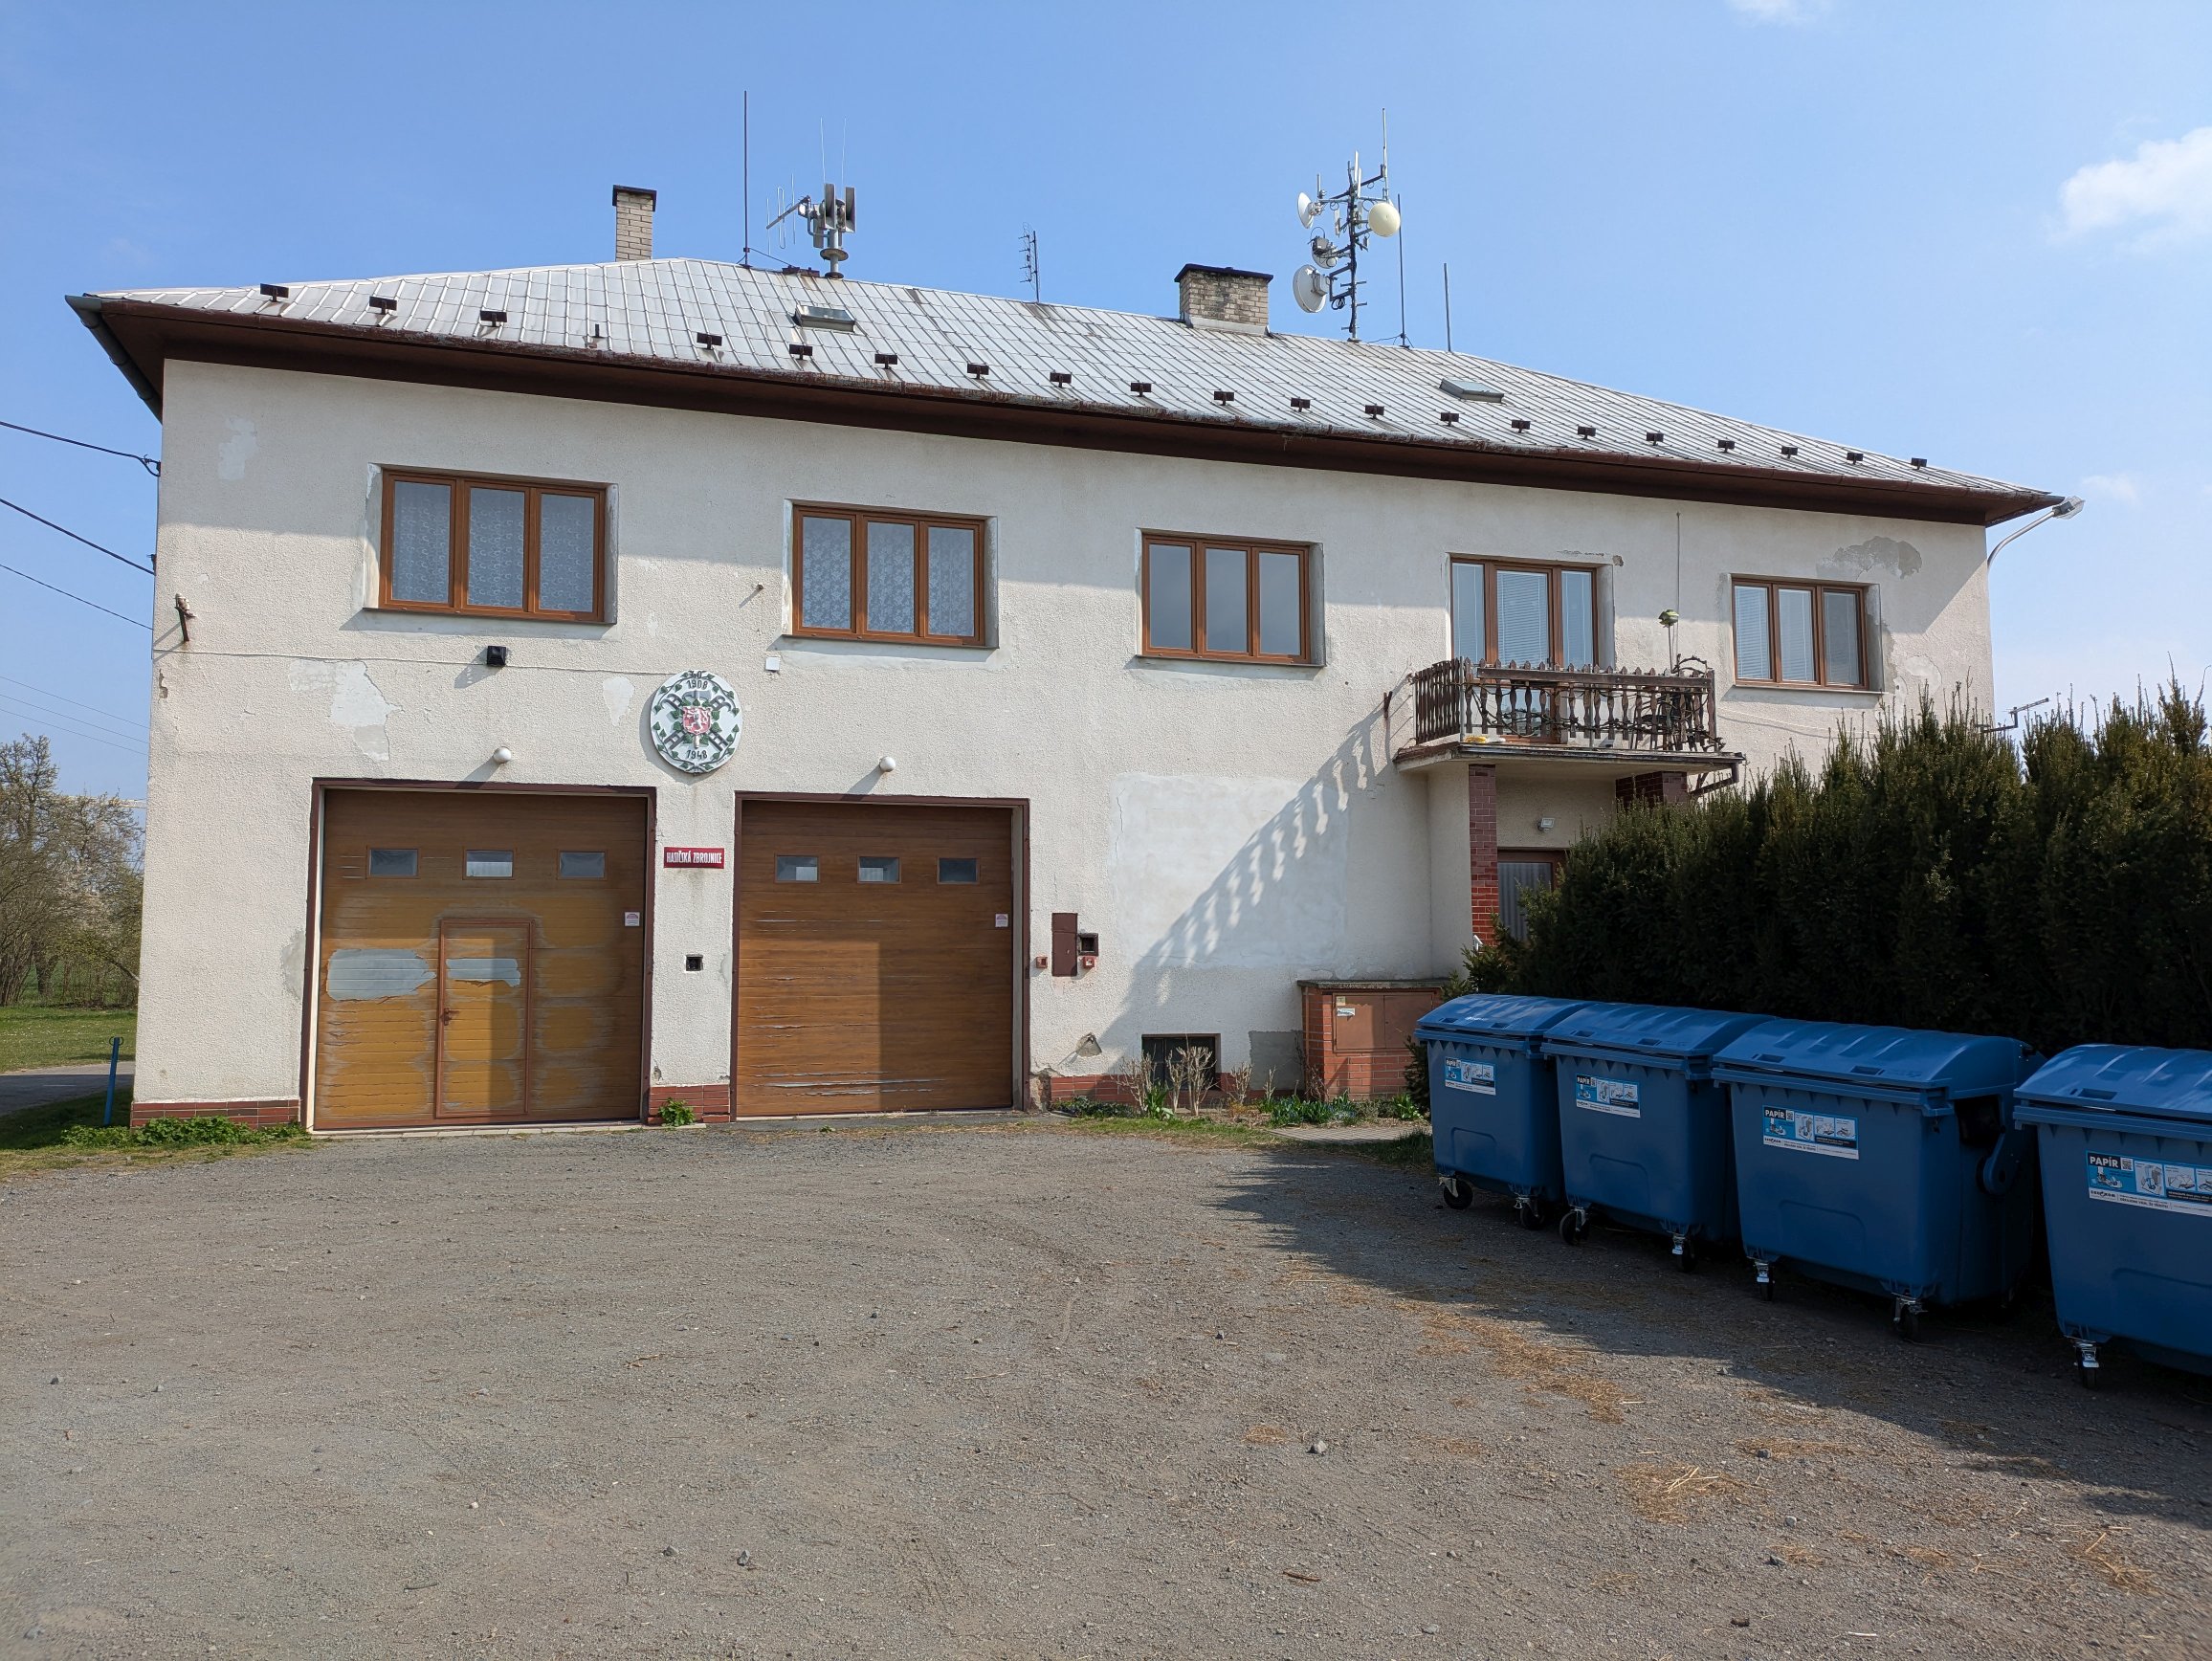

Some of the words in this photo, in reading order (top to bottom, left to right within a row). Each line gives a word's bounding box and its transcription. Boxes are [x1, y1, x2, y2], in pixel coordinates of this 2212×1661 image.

[686, 680, 708, 690] 1908
[686, 750, 708, 760] 1948
[693, 852, 722, 864] ZBROJNICE
[1577, 1076, 1590, 1085] PAPÍR
[1764, 1109, 1785, 1118] PAPÍR
[2090, 1156, 2118, 1168] PAPÍR
